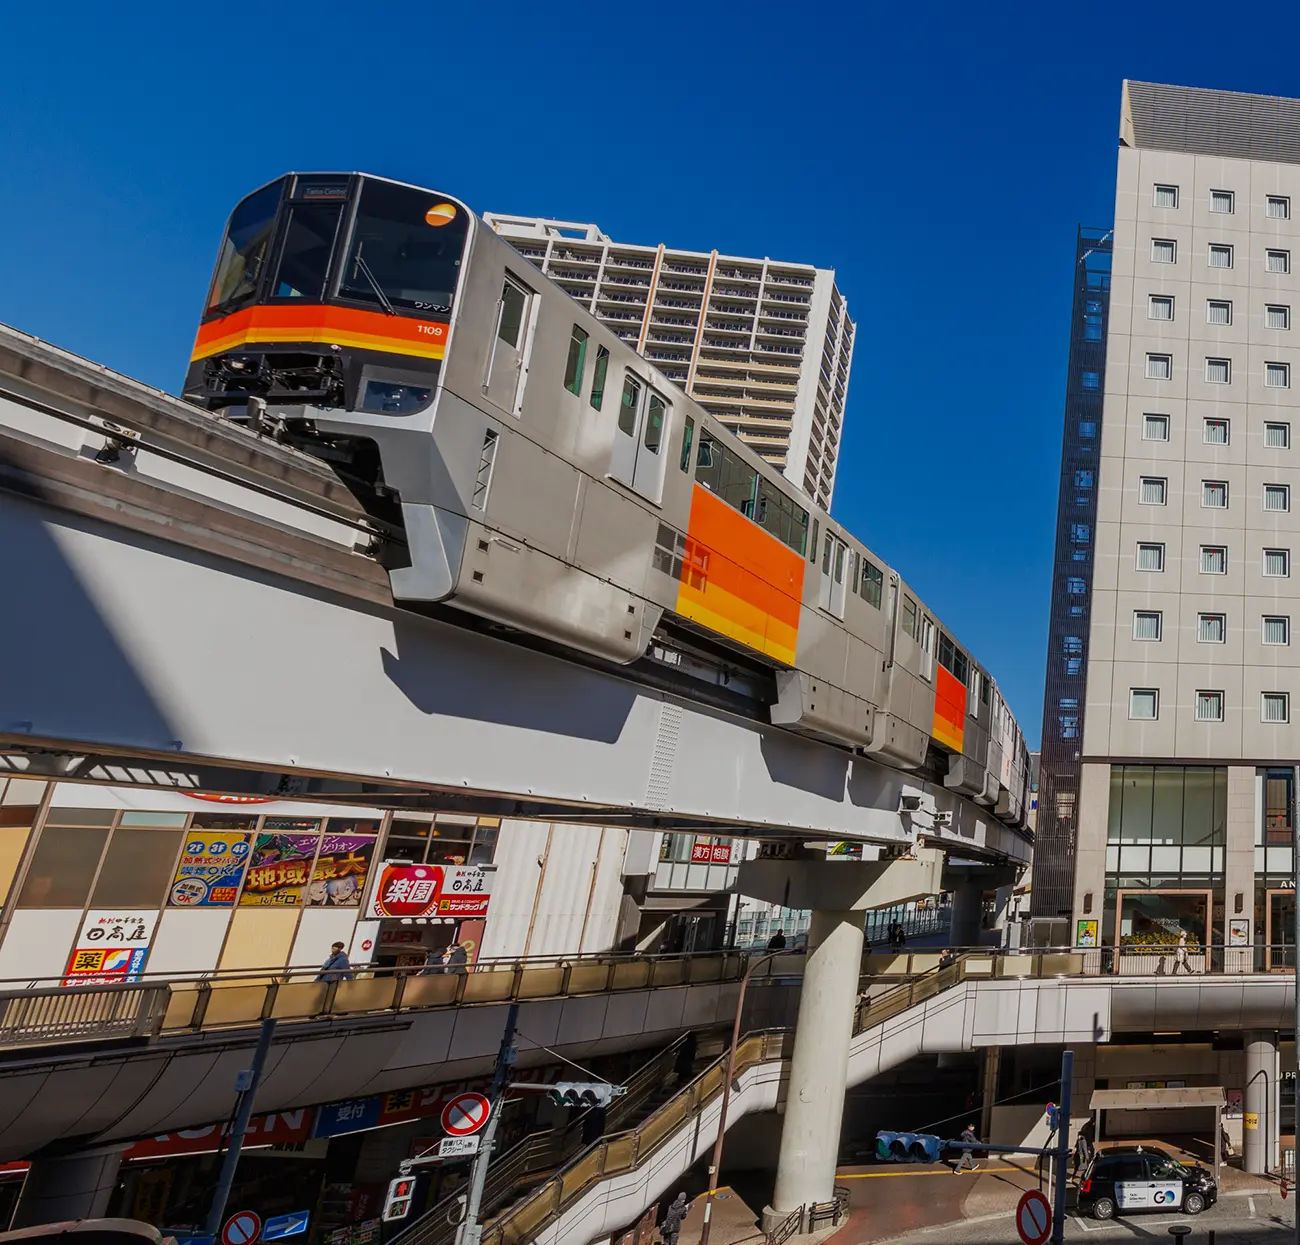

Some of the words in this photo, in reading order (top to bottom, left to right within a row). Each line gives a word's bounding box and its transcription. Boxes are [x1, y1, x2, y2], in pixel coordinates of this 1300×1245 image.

[414, 301, 450, 312] ワンマン
[417, 325, 443, 336] 1109
[188, 843, 204, 853] 2F
[210, 844, 226, 853] 3F
[232, 845, 247, 853] 4F
[247, 852, 366, 889] 地域最大
[383, 878, 437, 903] 楽園
[452, 879, 484, 892] 日高屋
[177, 894, 193, 903] OK
[86, 925, 148, 942] 日高屋
[75, 952, 103, 970] 薬
[335, 1104, 366, 1123] 受付
[1153, 1190, 1176, 1205] GO
